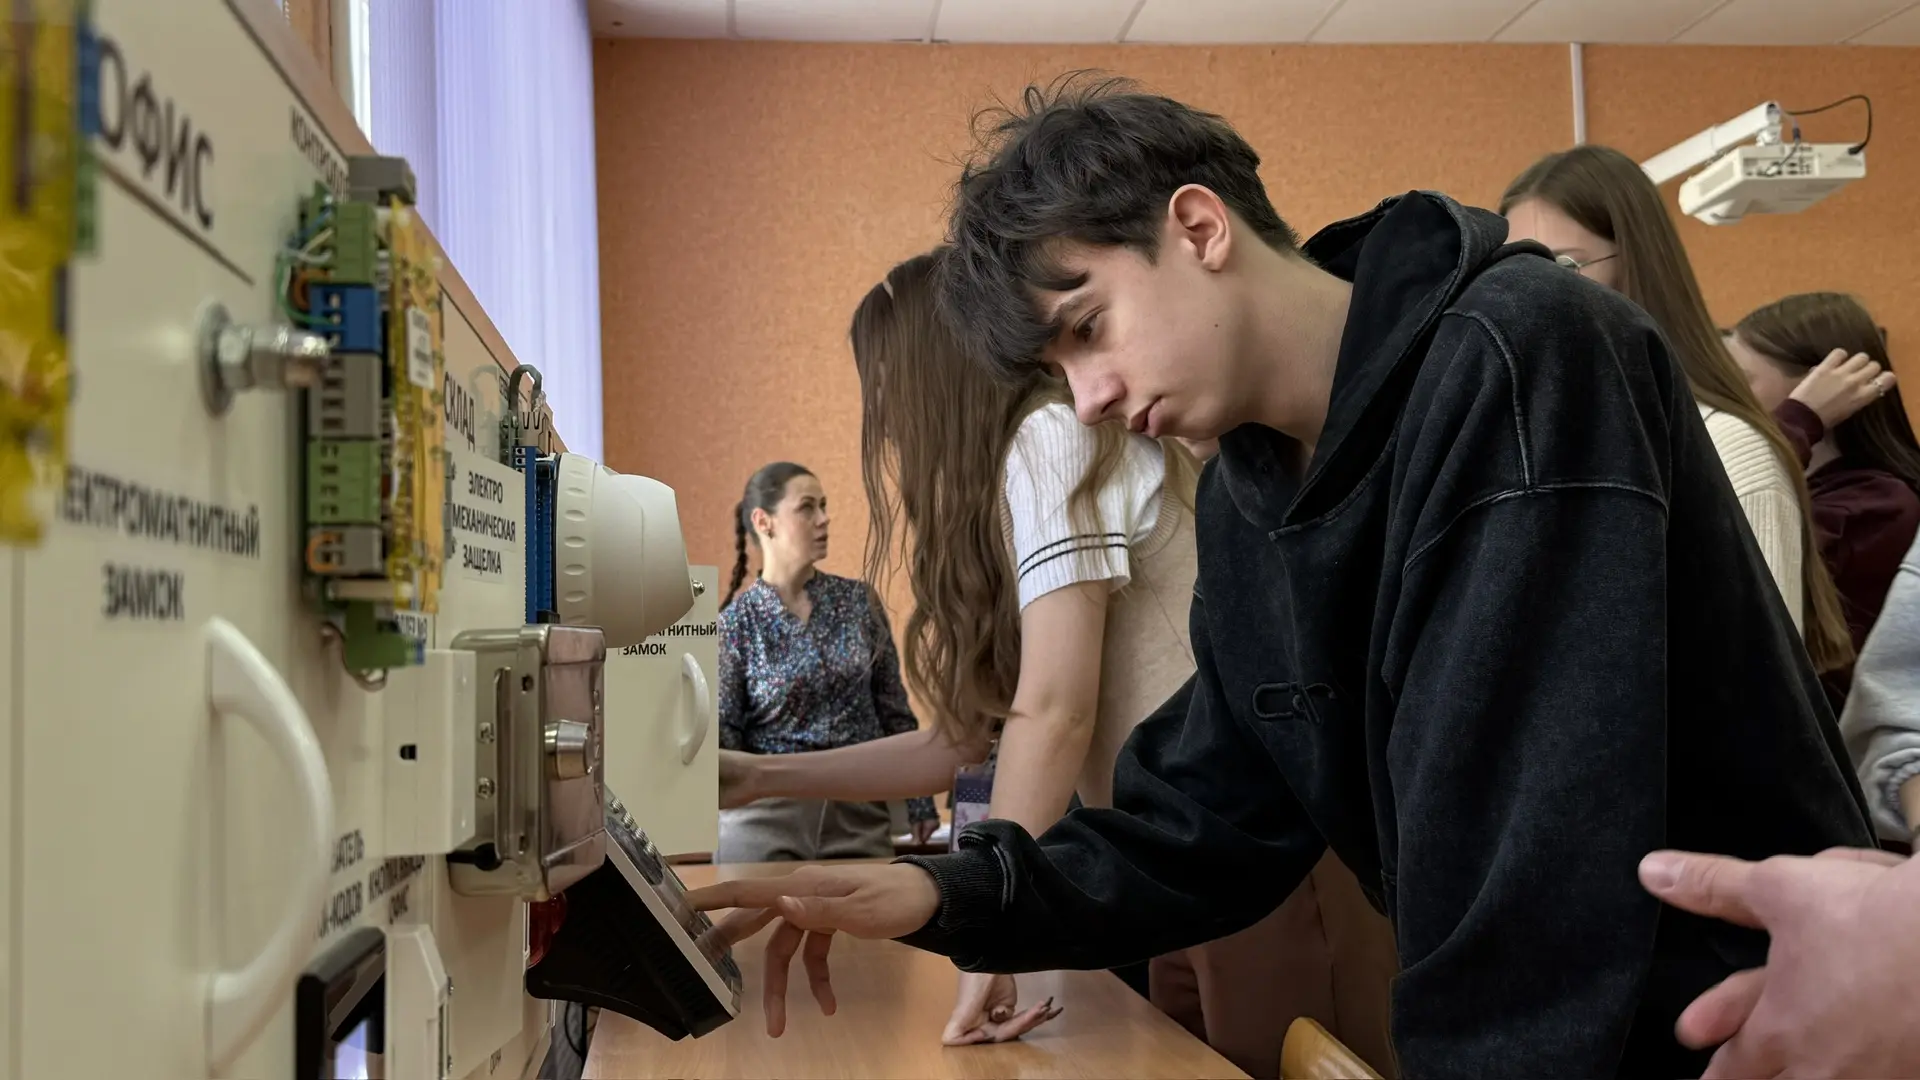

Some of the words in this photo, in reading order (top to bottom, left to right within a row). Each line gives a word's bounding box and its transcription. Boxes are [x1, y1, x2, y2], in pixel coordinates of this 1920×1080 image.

[95, 36, 214, 231] ОФИС
[443, 371, 475, 453] СКЛАД
[468, 470, 503, 504] ЭЛЕКТРО
[452, 503, 516, 542] МЕХАНИЧЕСКАЯ
[463, 543, 502, 576] ЗАЩЕЛКА
[103, 562, 185, 621] ЗАМОК
[623, 643, 667, 655] ЗАМОК
